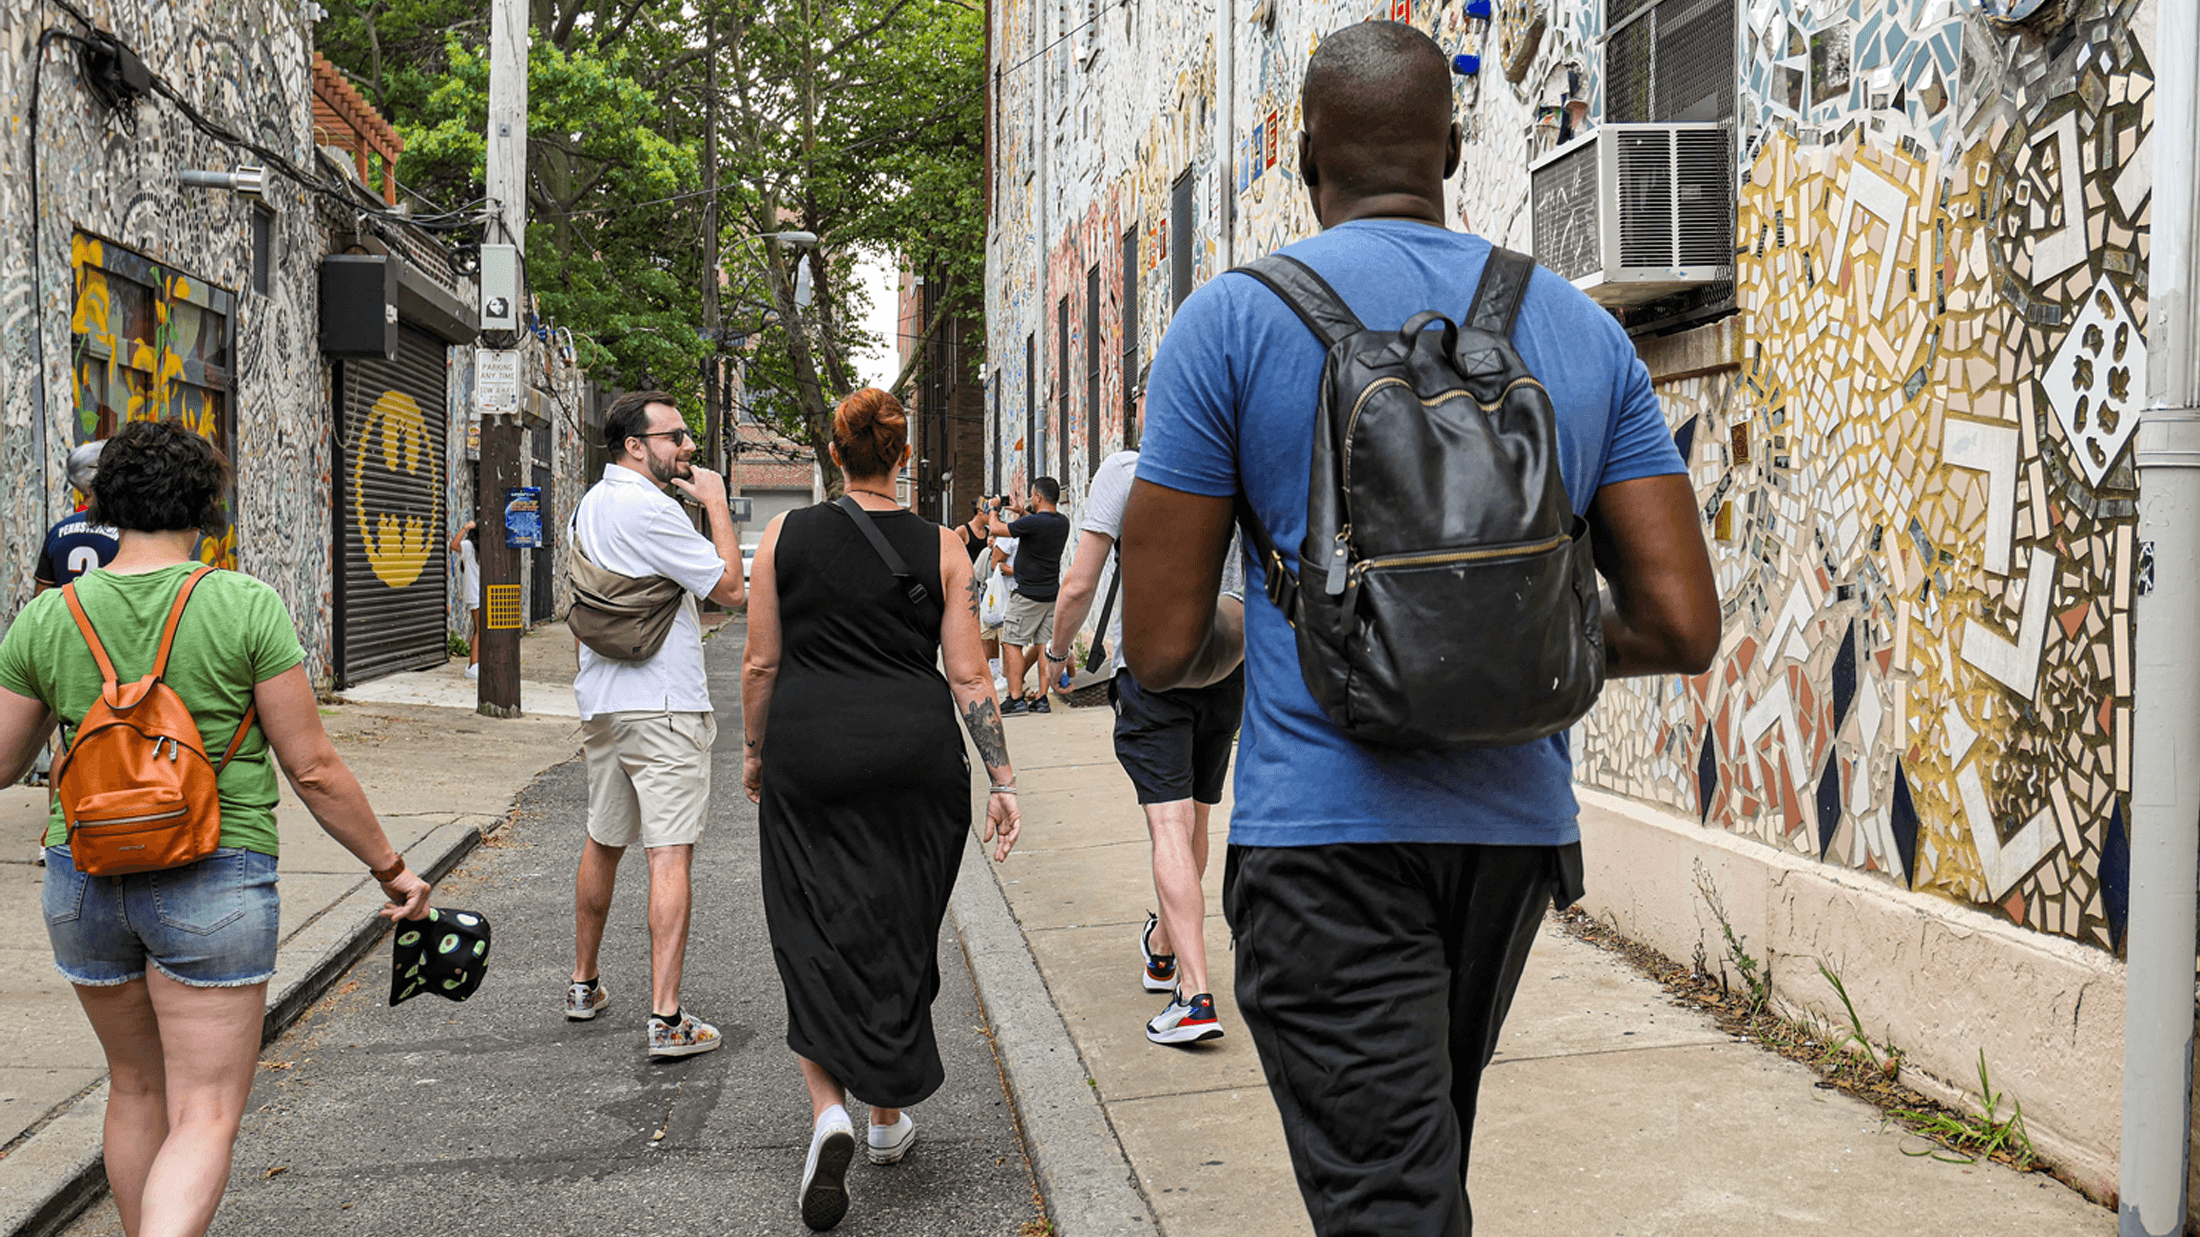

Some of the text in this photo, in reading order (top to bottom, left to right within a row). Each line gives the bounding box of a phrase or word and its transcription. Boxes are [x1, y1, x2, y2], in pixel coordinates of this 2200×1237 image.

[491, 354, 502, 363] NO
[482, 363, 514, 372] PARKING
[480, 372, 515, 380] ANY TIME
